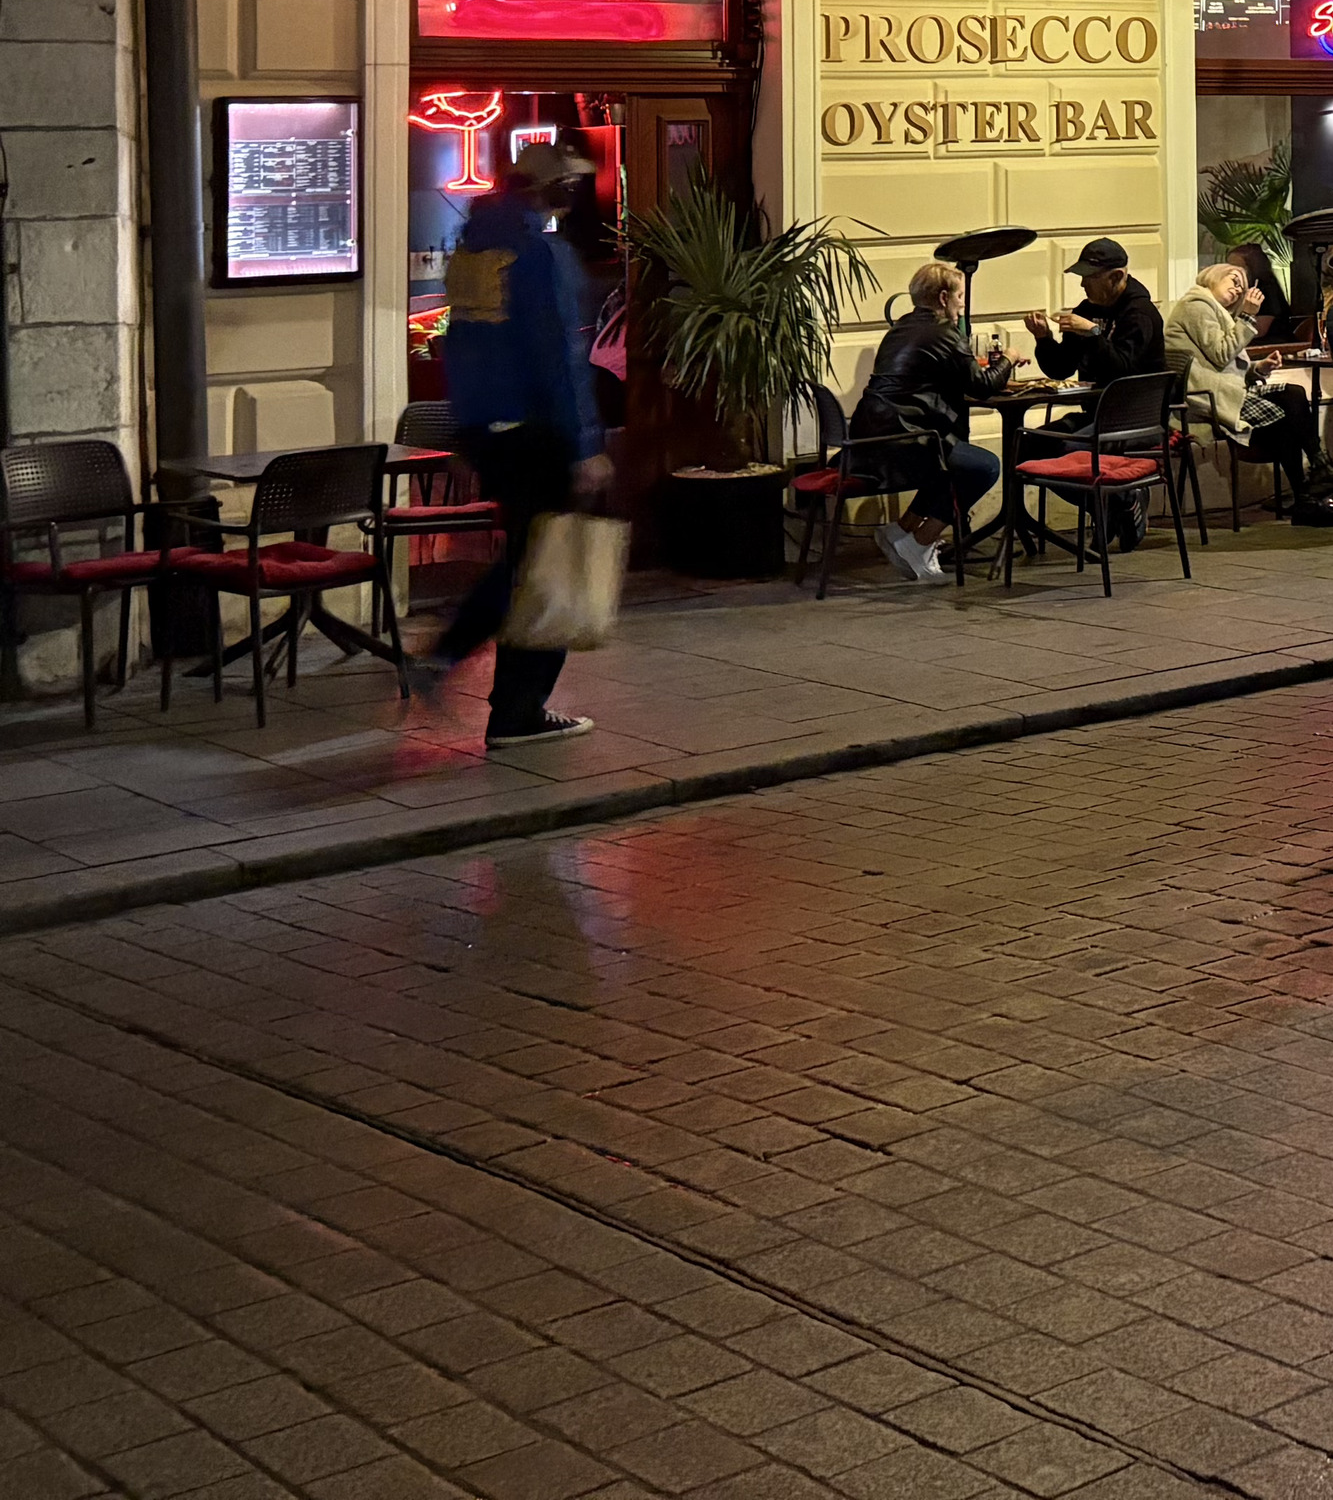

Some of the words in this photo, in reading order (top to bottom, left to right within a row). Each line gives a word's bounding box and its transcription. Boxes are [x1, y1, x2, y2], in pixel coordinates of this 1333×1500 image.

[820, 13, 1159, 65] PROSECCO
[821, 101, 1043, 147] OYSTER
[1049, 100, 1158, 144] BAR
